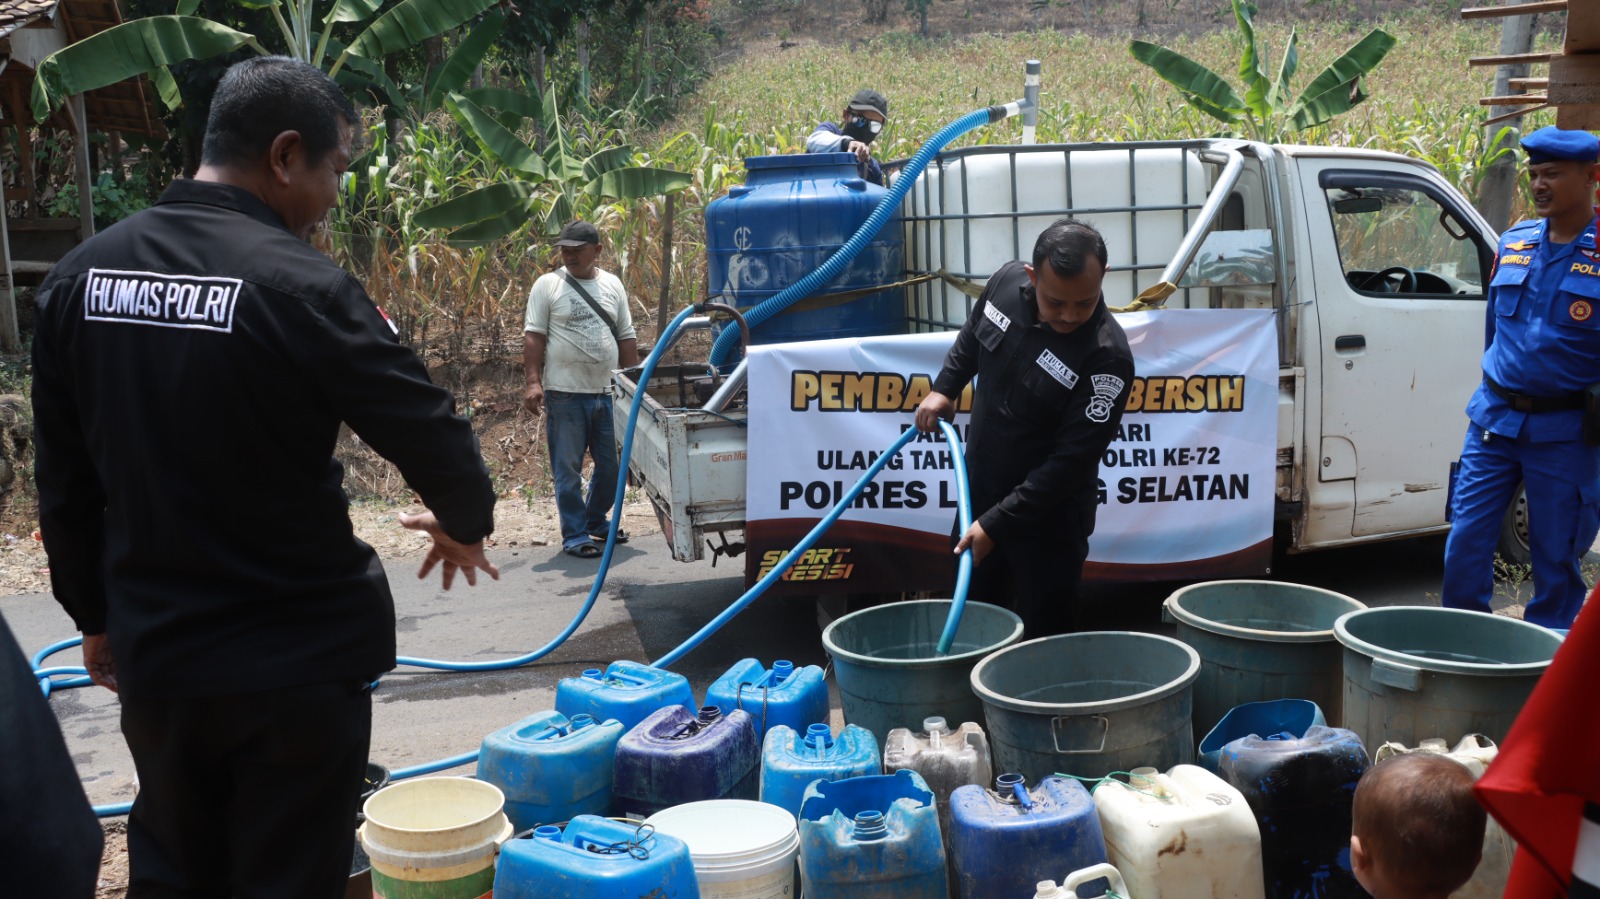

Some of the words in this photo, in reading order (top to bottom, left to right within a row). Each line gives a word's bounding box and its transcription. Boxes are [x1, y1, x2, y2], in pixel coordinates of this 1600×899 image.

[1570, 263, 1600, 276] POL
[91, 277, 164, 317] HUMAS
[164, 283, 230, 323] POLRI
[1043, 351, 1074, 382] HUMAS
[1123, 375, 1245, 413] BERSIH
[1111, 424, 1151, 442] ARI
[711, 453, 732, 462] Gran
[1102, 448, 1156, 467] OLRI
[1163, 446, 1221, 466] KE-72
[1117, 474, 1249, 504] SELATAN
